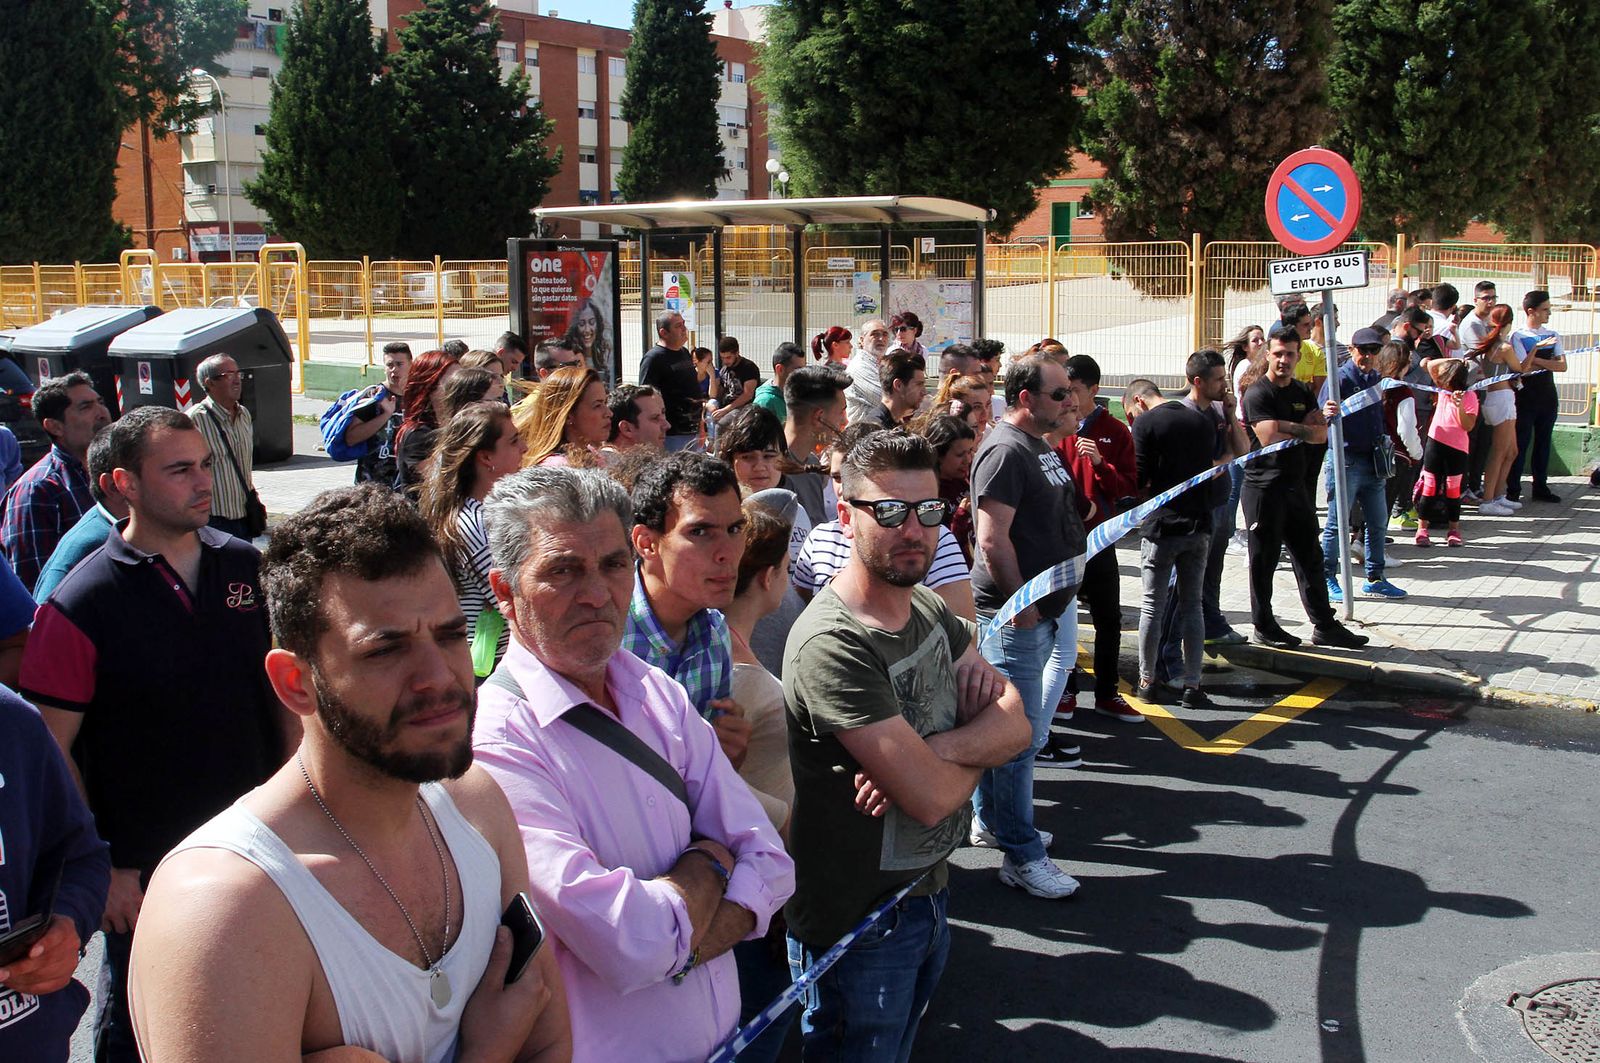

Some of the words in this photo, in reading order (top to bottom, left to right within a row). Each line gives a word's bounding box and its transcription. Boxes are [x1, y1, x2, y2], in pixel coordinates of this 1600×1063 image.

[924, 242, 932, 252] 7
[531, 258, 562, 272] one
[1273, 261, 1330, 274] EXCEPTO
[1334, 256, 1360, 268] BUS
[531, 276, 552, 284] Chatea
[553, 276, 567, 284] todo
[1291, 276, 1343, 289] EMTUSA
[531, 285, 538, 293] lo
[538, 287, 550, 295] que
[551, 286, 573, 295] quieras
[531, 294, 541, 302] sin
[542, 295, 560, 303] gastar
[561, 294, 578, 302] datos
